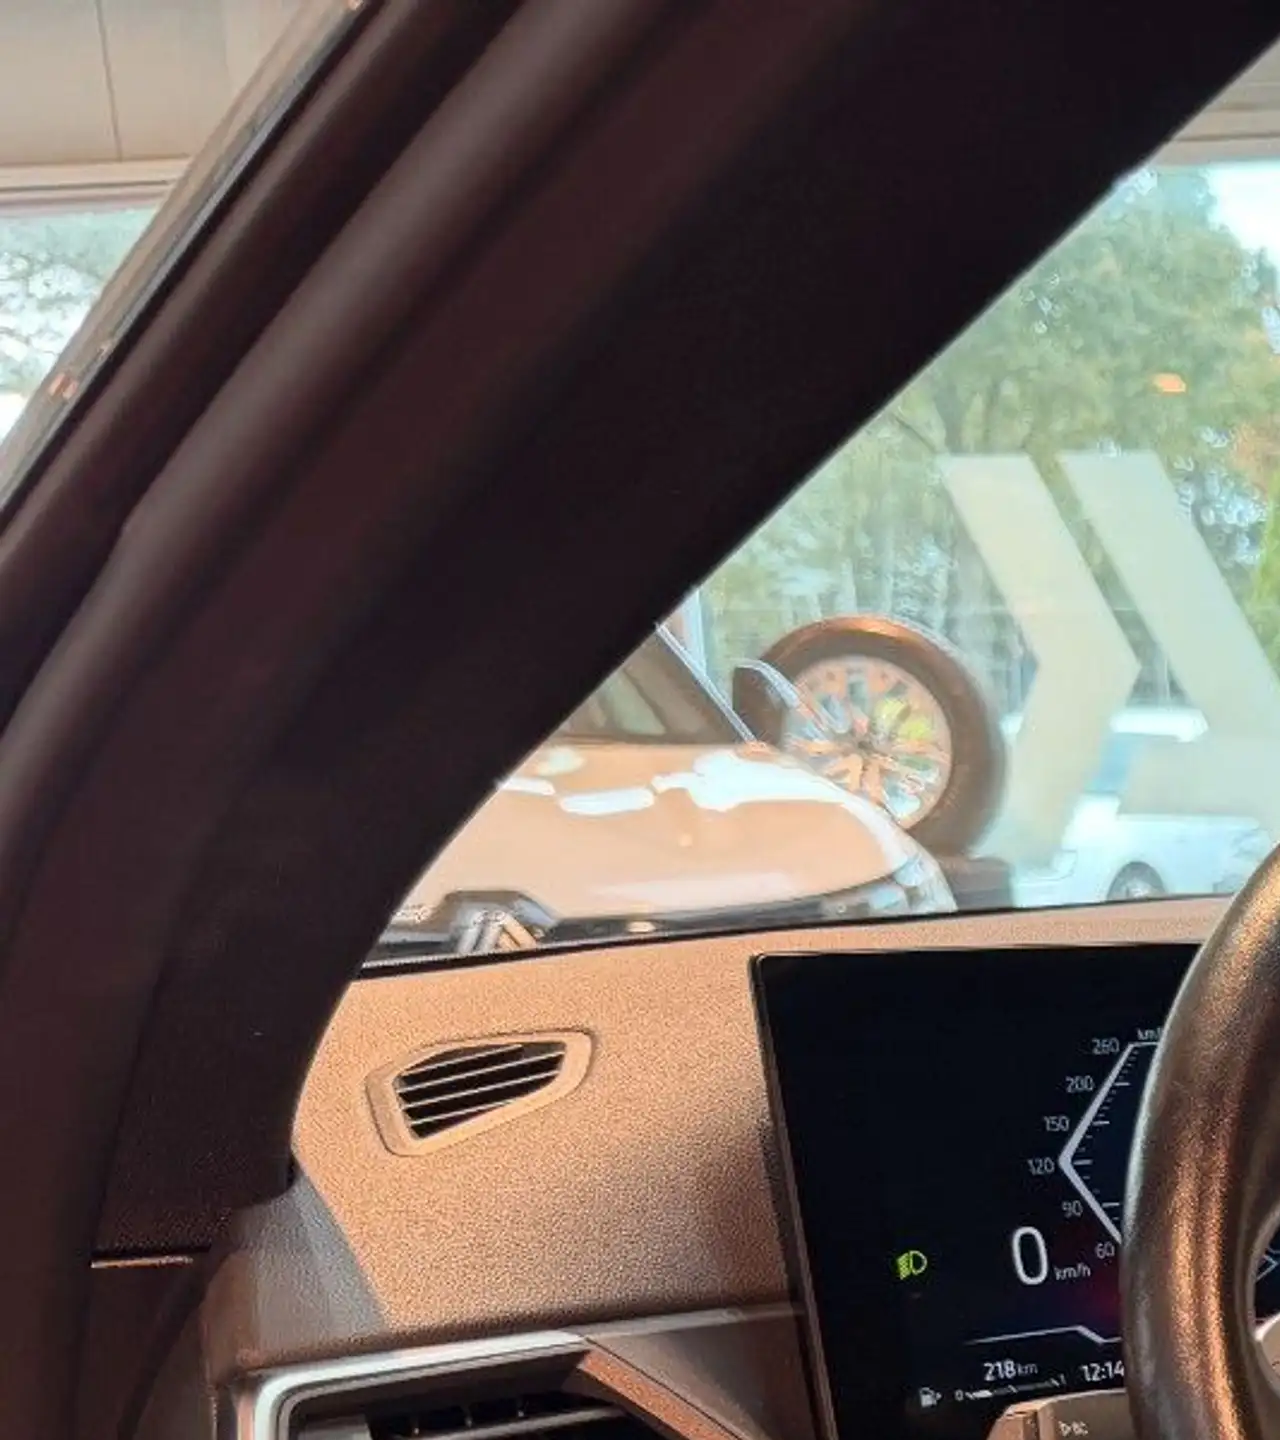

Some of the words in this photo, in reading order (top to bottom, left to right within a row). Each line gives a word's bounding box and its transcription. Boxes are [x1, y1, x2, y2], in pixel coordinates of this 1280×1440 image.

[1065, 1075, 1094, 1093] 200
[1044, 1115, 1070, 1132] 150
[1028, 1157, 1055, 1175] 120
[1062, 1200, 1084, 1218] 90
[1011, 1225, 1049, 1286] 0
[1054, 1260, 1092, 1281] km/h
[1095, 1242, 1116, 1259] 60
[983, 1359, 1017, 1382] 218
[1017, 1363, 1039, 1377] km
[1081, 1360, 1126, 1383] 12:14
